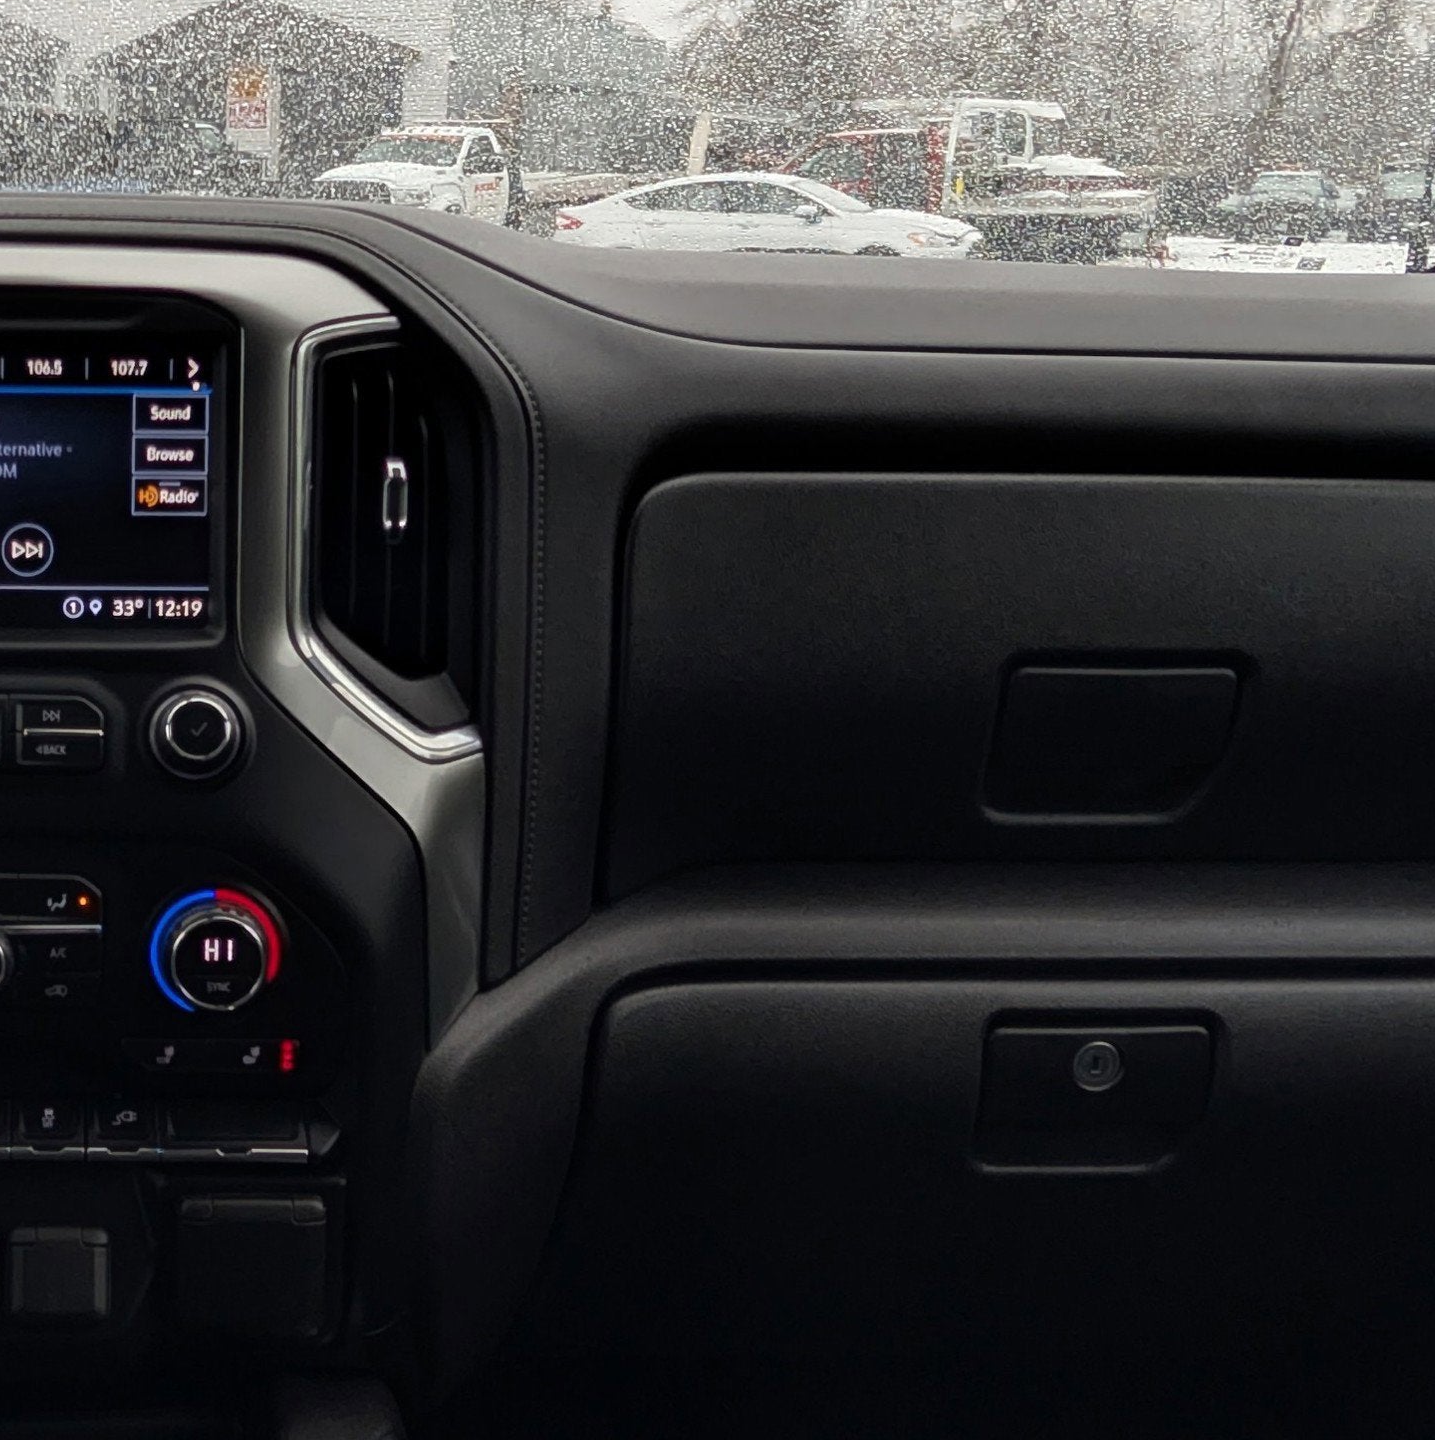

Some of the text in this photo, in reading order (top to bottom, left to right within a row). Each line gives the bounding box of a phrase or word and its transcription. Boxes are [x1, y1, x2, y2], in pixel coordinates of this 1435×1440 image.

[27, 359, 63, 376] 106.5
[110, 359, 149, 377] 107.7
[150, 404, 192, 421] Sound
[146, 446, 194, 462] Browse
[159, 489, 196, 505] Radio
[155, 599, 203, 617] 12:19
[42, 744, 68, 757] BACK
[49, 947, 67, 959] A/C
[203, 938, 234, 962] HI
